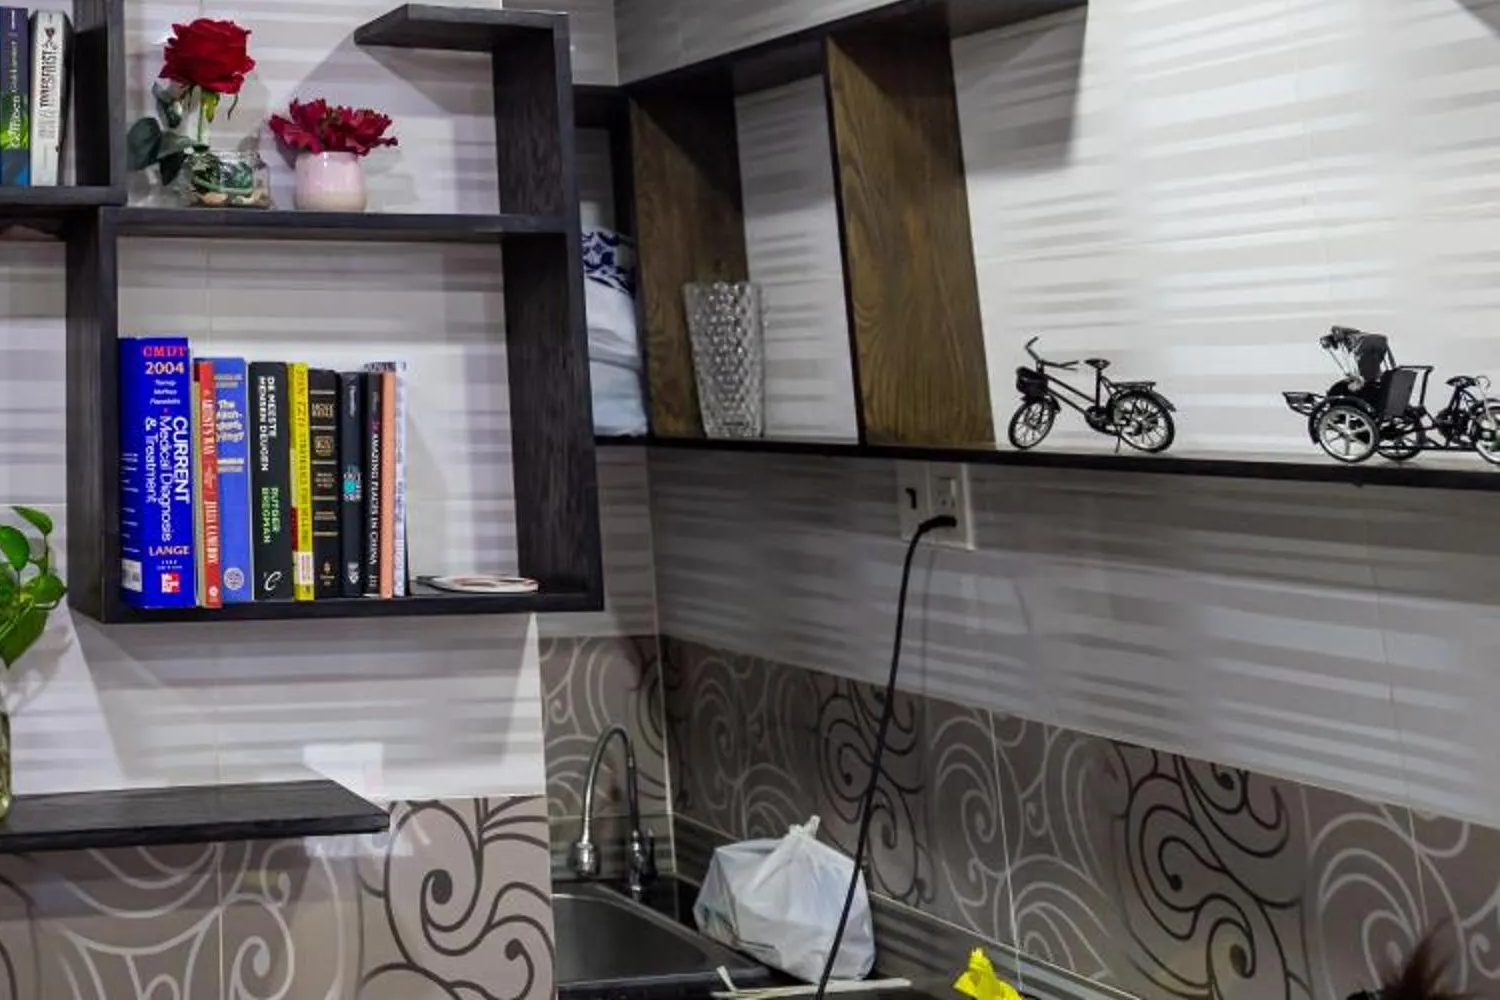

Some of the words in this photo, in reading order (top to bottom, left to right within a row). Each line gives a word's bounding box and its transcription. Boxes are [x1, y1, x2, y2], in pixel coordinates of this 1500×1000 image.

[144, 361, 185, 375] 2004
[258, 376, 268, 421] MENSEN
[267, 392, 277, 438] MEESTE
[145, 417, 157, 431] &
[159, 416, 172, 470] Medical
[145, 434, 157, 504] Treatment
[172, 416, 190, 503] CURRENT
[259, 424, 269, 471] DEUGEN
[371, 432, 379, 478] AMAZING
[158, 472, 173, 542] Diagnosis
[262, 486, 271, 544] BREGMAN
[148, 545, 190, 556] LANGE
